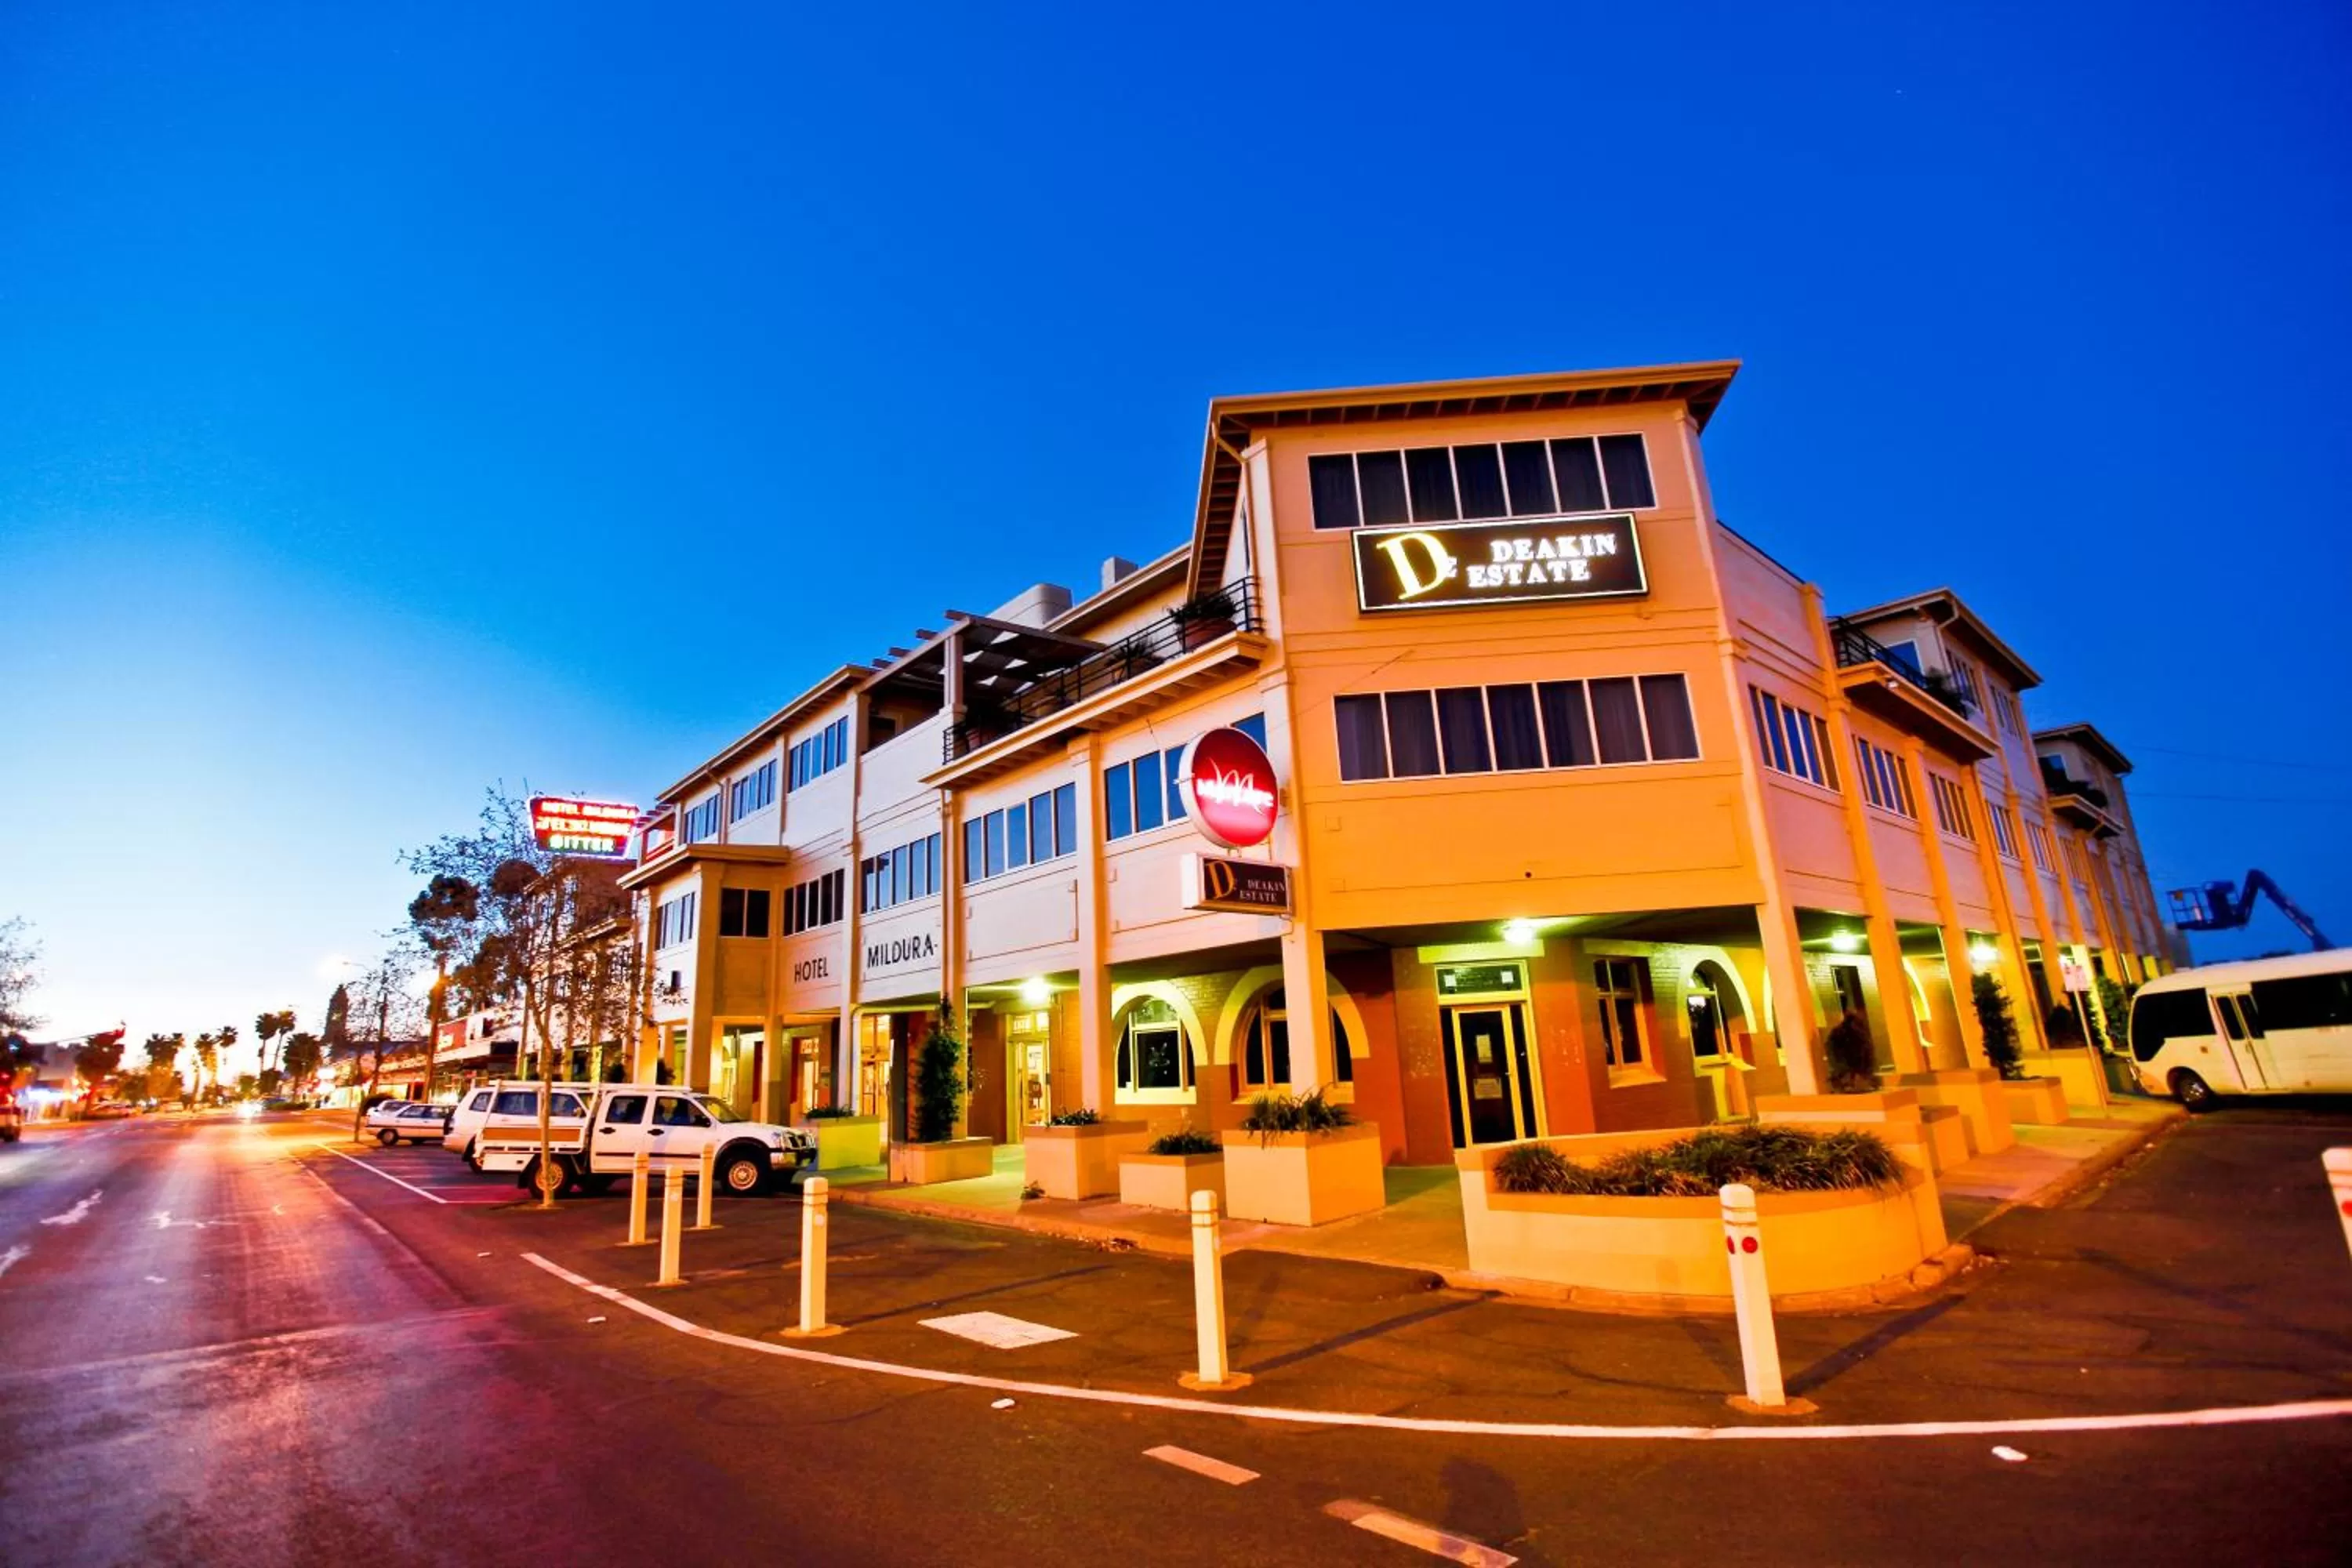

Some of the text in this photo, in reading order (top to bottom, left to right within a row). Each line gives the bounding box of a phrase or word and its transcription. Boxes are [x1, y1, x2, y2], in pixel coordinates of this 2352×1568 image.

[1490, 533, 1617, 563] DEAKIN
[1466, 558, 1591, 587] ESTATE
[1240, 889, 1277, 902] ESTATE
[1247, 878, 1286, 891] DEAKIN
[794, 933, 934, 982] HOTEL MILDURA
